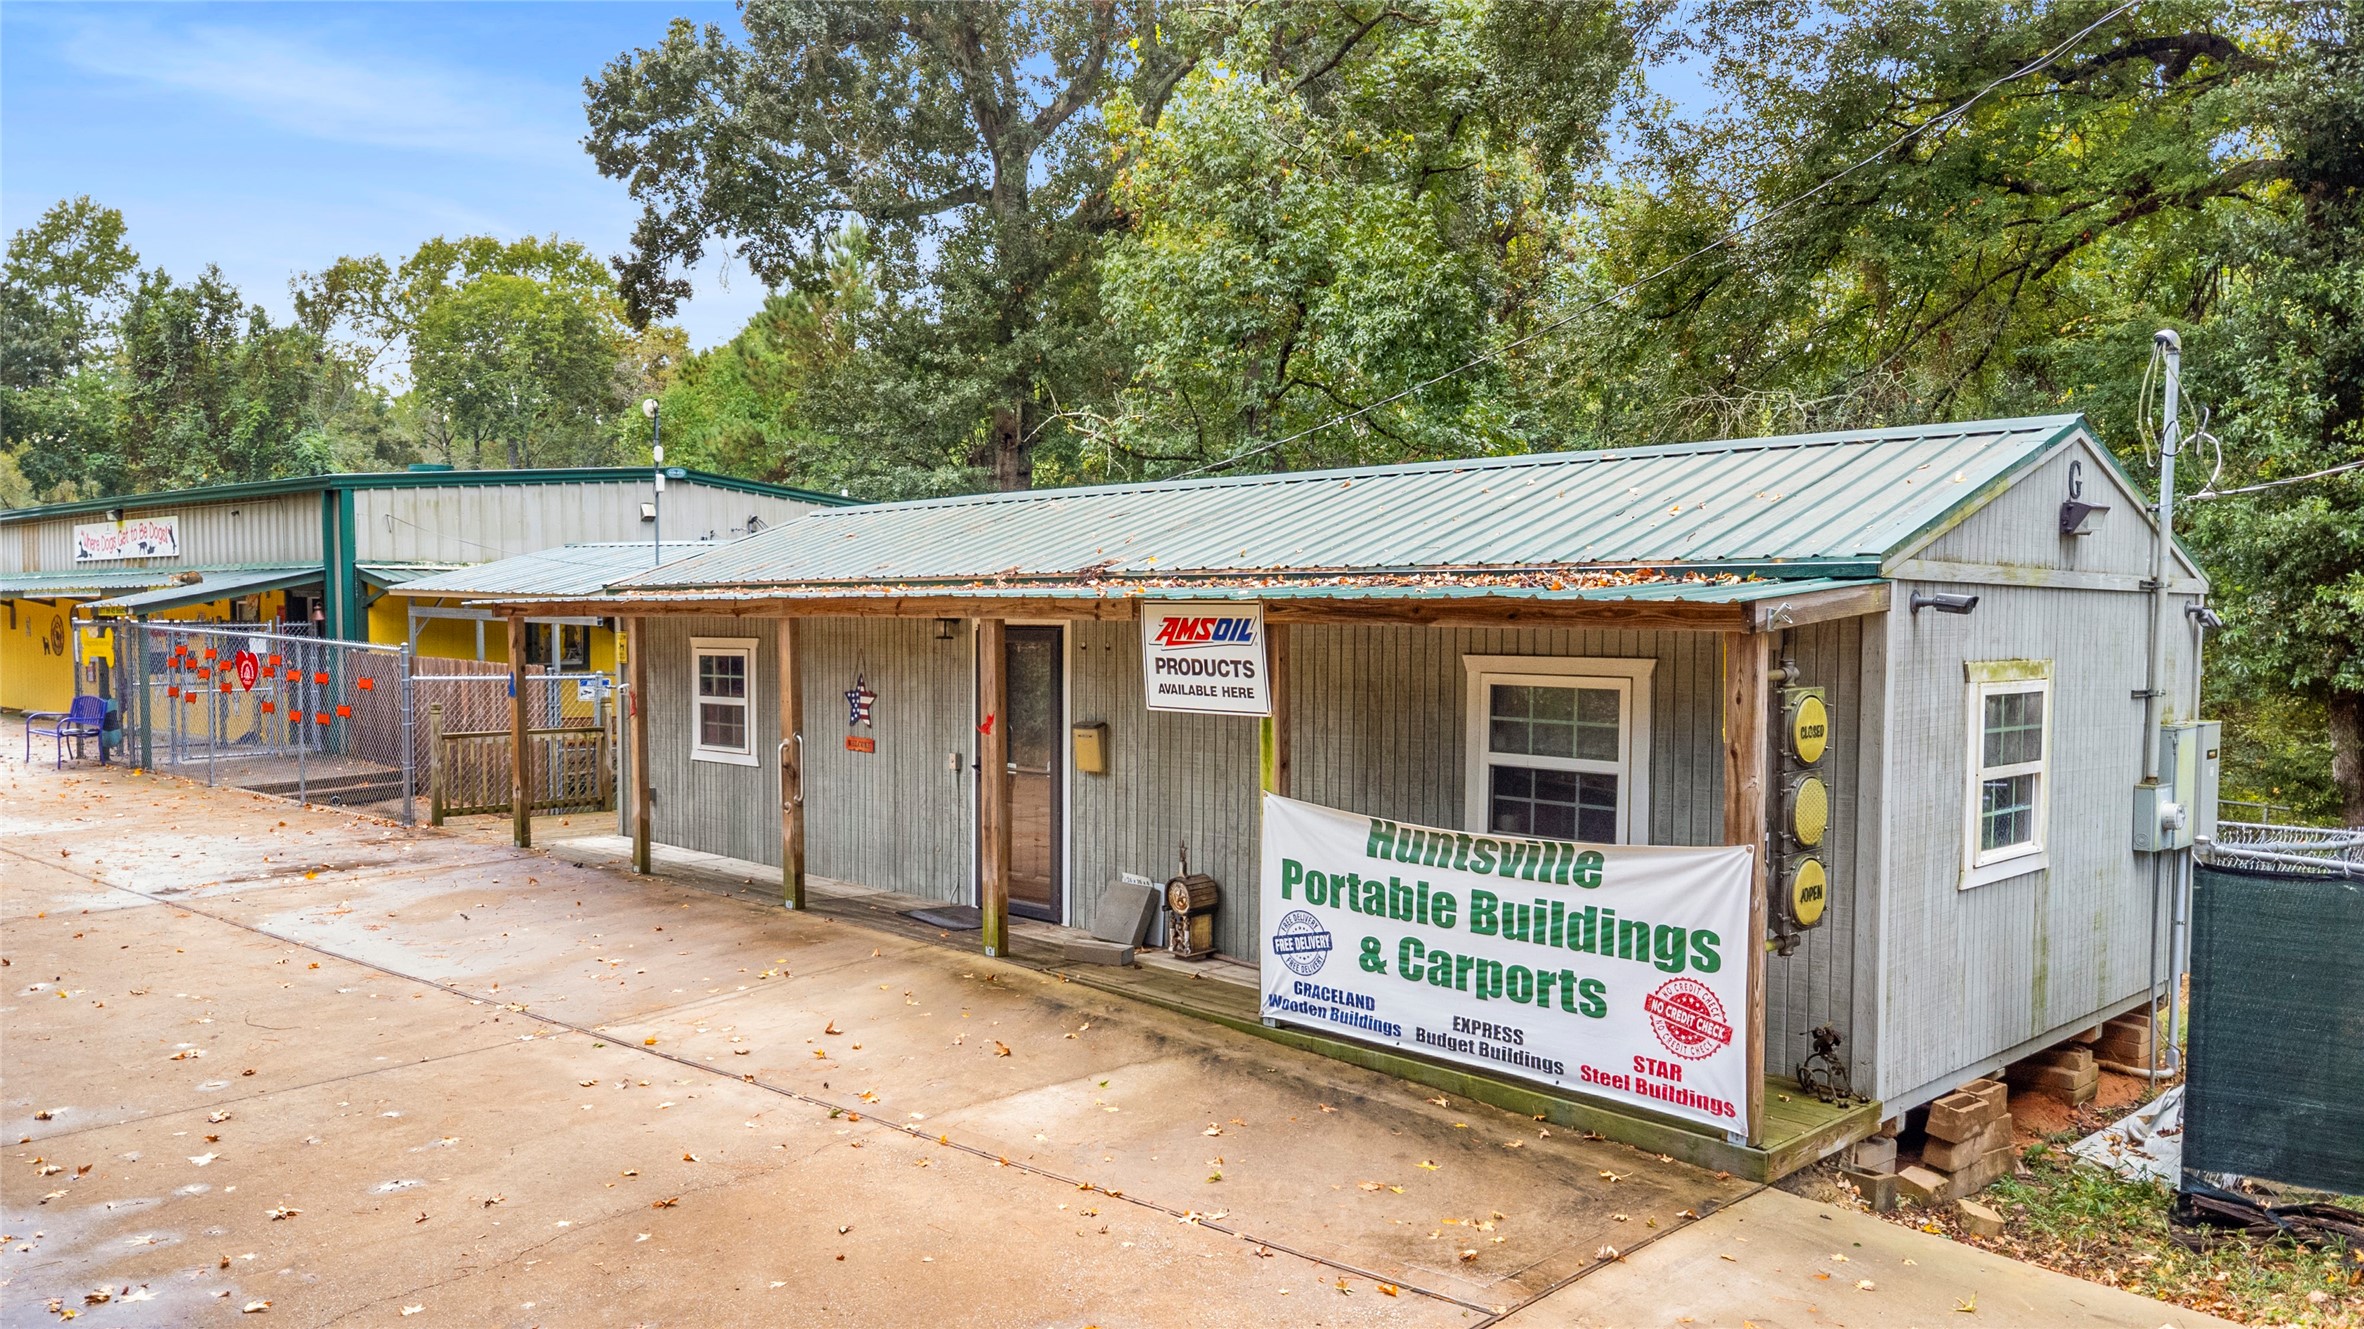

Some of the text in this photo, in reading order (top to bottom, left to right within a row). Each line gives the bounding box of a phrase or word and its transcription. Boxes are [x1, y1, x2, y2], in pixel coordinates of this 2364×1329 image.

[2069, 460, 2082, 499] G
[102, 535, 117, 554] Dogs
[118, 527, 129, 546] Get
[131, 527, 137, 540] to
[140, 522, 147, 539] Be
[1155, 617, 1253, 647] AMSOIL
[1155, 657, 1255, 678] PRODUCTS
[1158, 683, 1255, 699] AVAILABLE HERE
[1800, 724, 1825, 739] CLOSED
[1366, 818, 1605, 889] Huntsville
[1281, 913, 1319, 932] FREE DELIVERY
[1282, 858, 1721, 974] Portable Buildings
[1275, 934, 1330, 952] FREE DELIVERY
[1286, 955, 1323, 973] FREE DELIVERY
[1358, 935, 1607, 1019] & Carports
[1294, 980, 1375, 1011] GRACELAND
[1662, 982, 1720, 1018] NO CREDIT CHECK
[1268, 994, 1402, 1037] Wooden Buildings
[1452, 1015, 1524, 1046] EXPRESS
[1651, 999, 1726, 1040] NO CREDIT CHECK
[1415, 1026, 1564, 1076] Budget Buildings
[1656, 1019, 1713, 1055] NO CREDIT CHECK
[1633, 1055, 1682, 1082] STAR
[1580, 1064, 1736, 1118] Steel Buildings
